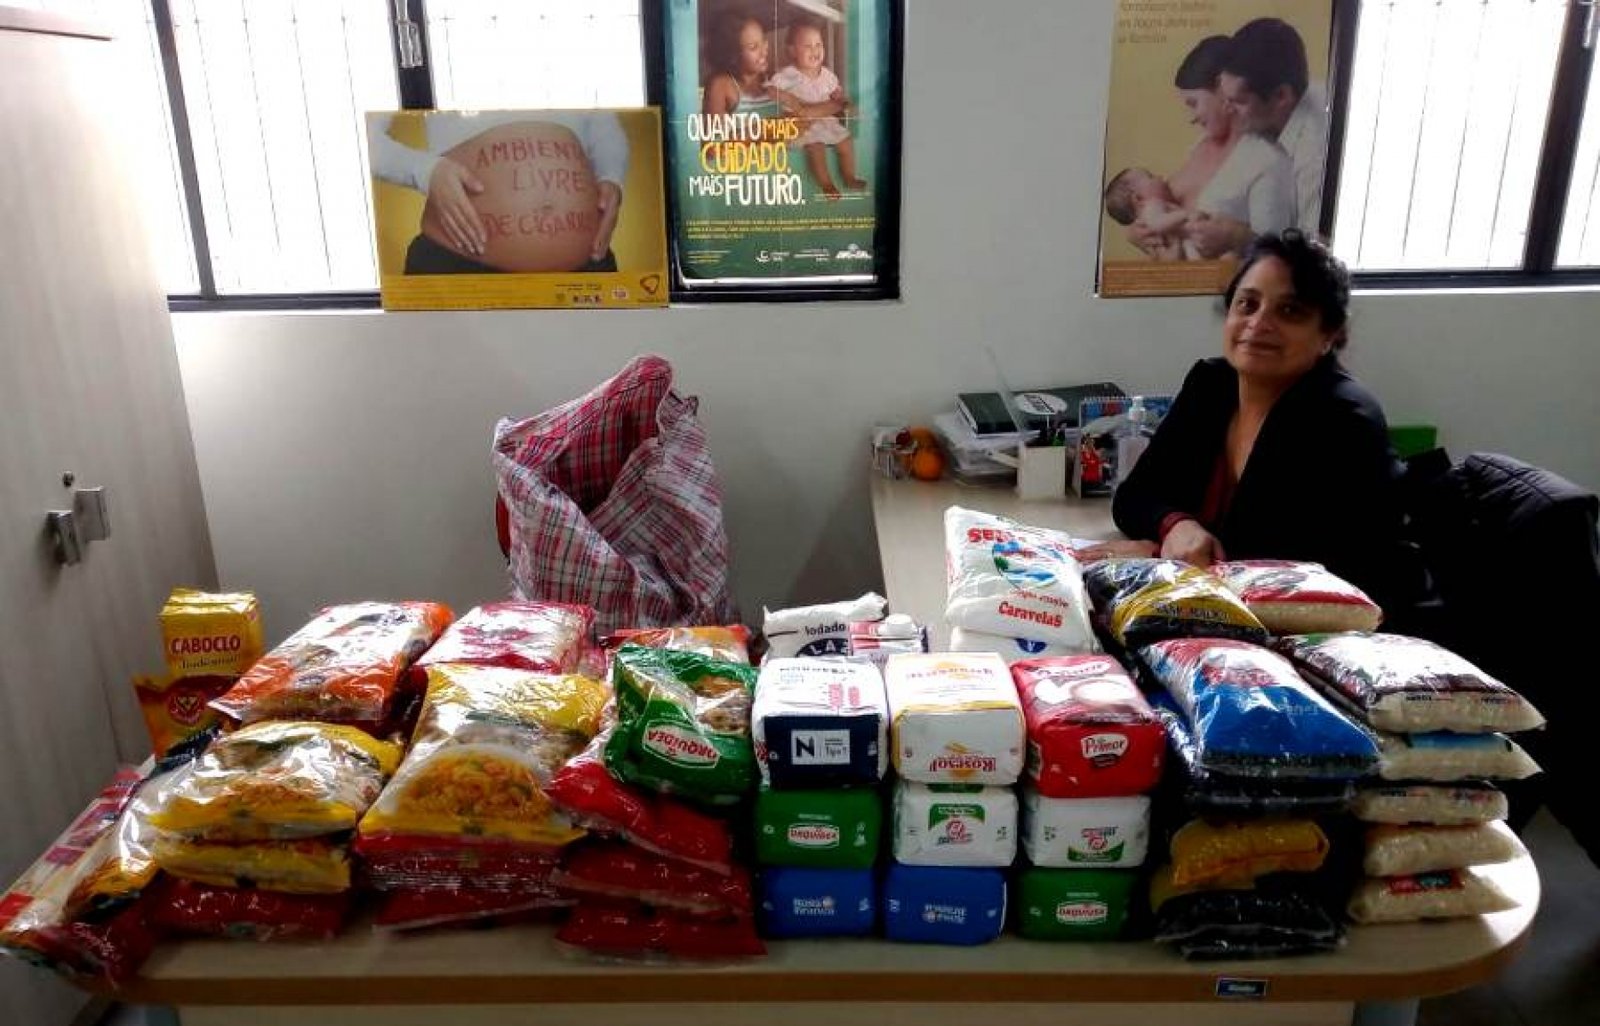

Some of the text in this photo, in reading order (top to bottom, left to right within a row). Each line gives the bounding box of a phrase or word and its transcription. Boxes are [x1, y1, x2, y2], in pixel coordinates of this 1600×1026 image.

[687, 113, 761, 142] QUANTO
[702, 142, 791, 174] CUIDADO.
[725, 174, 806, 206] FUTURO.
[998, 600, 1063, 628] Caravelas
[171, 634, 241, 655] CABOCLO
[1082, 736, 1127, 757] Primor
